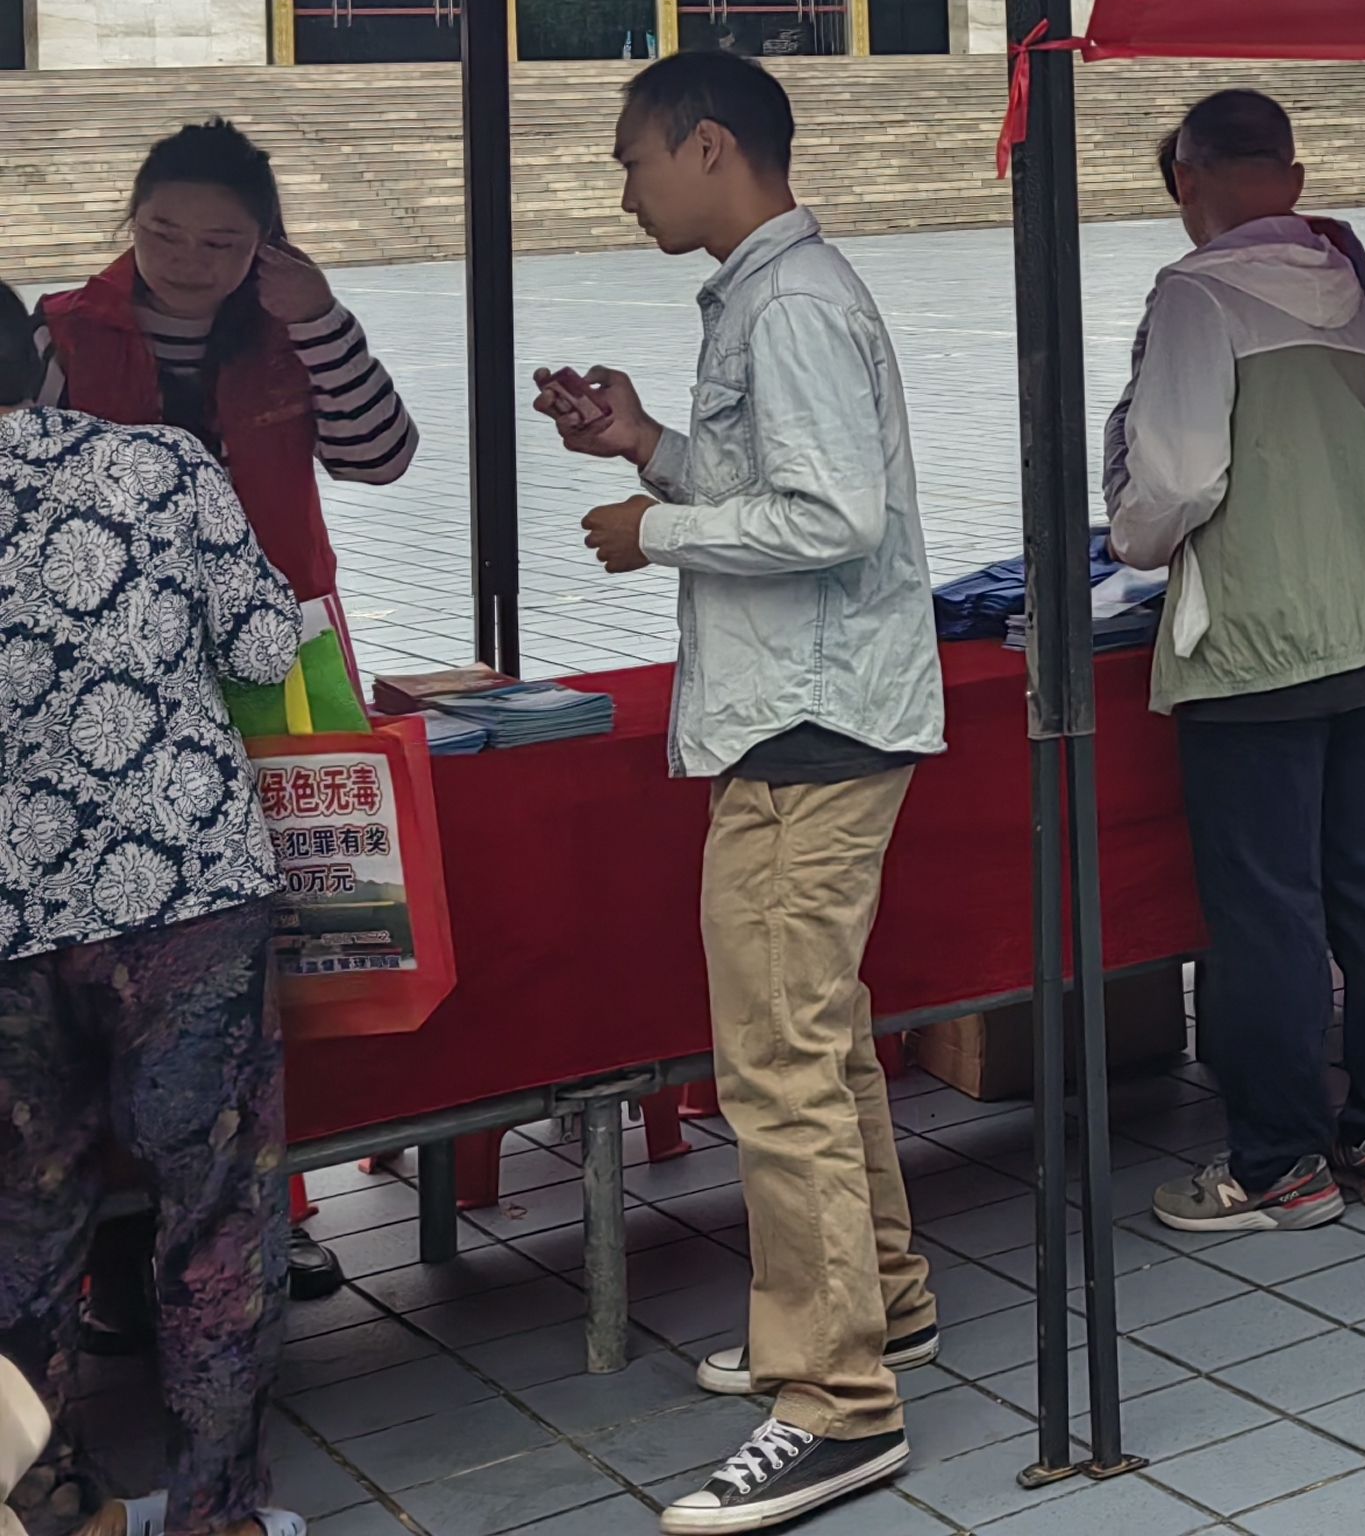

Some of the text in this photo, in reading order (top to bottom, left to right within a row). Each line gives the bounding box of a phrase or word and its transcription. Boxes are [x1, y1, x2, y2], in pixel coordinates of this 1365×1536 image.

[259, 764, 382, 820] 绿色无毒
[276, 865, 355, 895] 0万元
